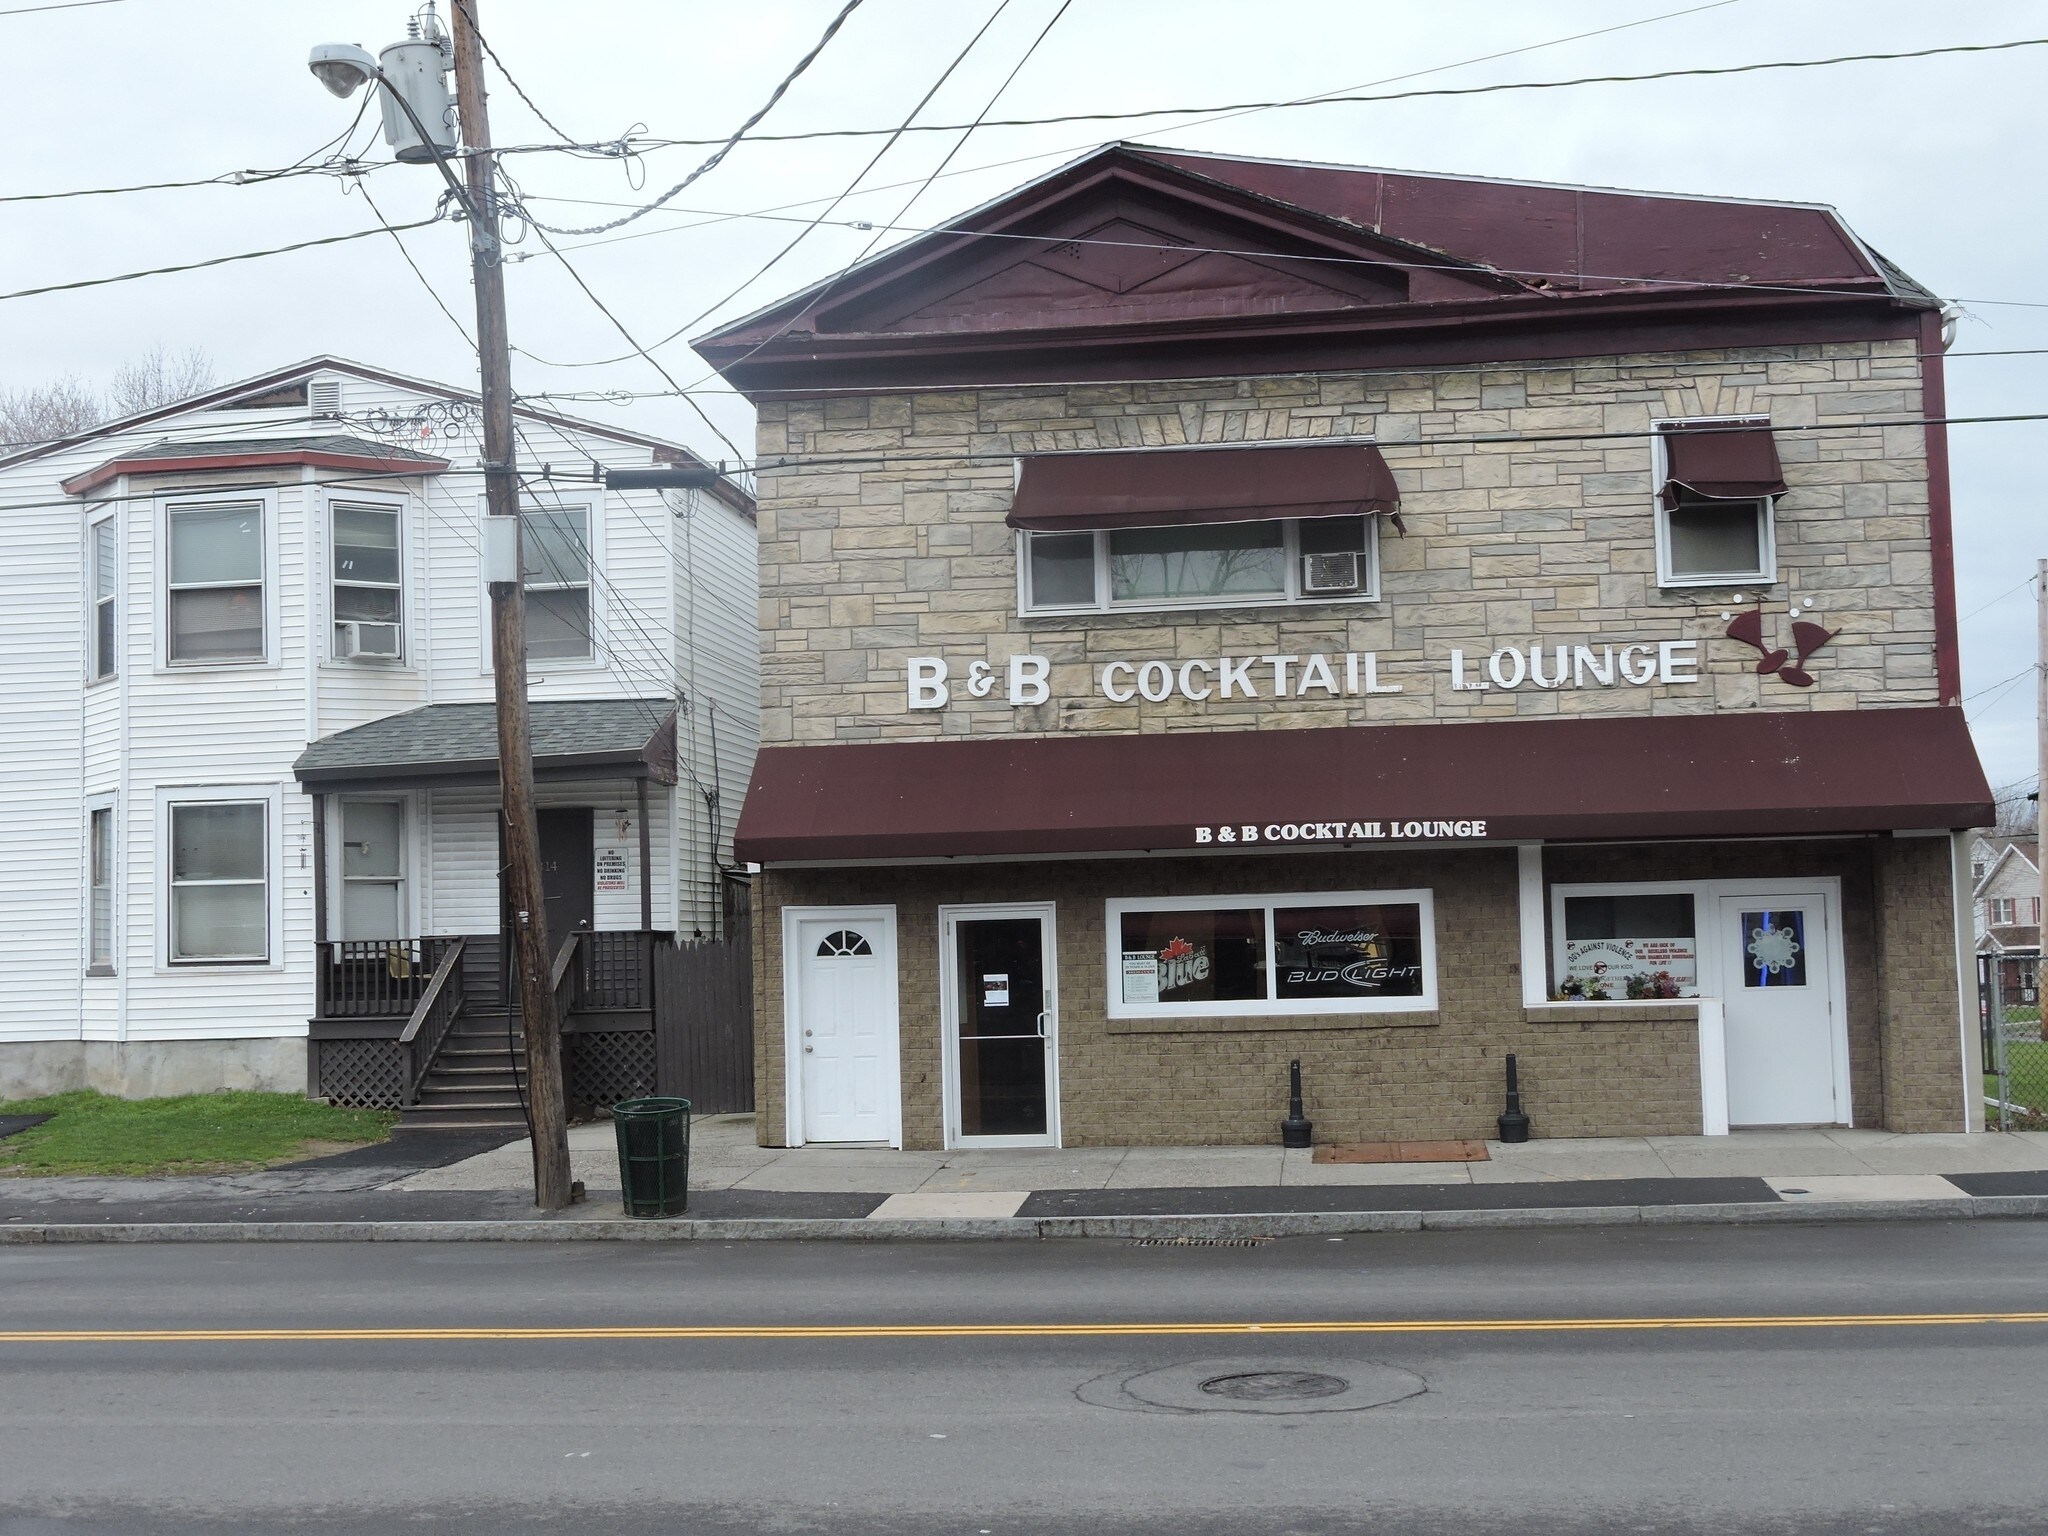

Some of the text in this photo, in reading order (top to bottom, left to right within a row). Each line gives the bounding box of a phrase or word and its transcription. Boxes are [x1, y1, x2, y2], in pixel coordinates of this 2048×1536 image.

[908, 640, 1698, 709] B & B COCKTAIL LOUNGE
[1195, 820, 1487, 843] B & B COCKTAIL LOUNGE
[540, 860, 558, 872] 14
[1298, 930, 1379, 946] Budweiser
[1176, 945, 1207, 964] Labatt
[1580, 942, 1605, 955] AGAINST
[1606, 943, 1634, 961] VIOLENCE
[1158, 955, 1211, 993] Blue
[1287, 966, 1421, 983] BUD LIGHT
